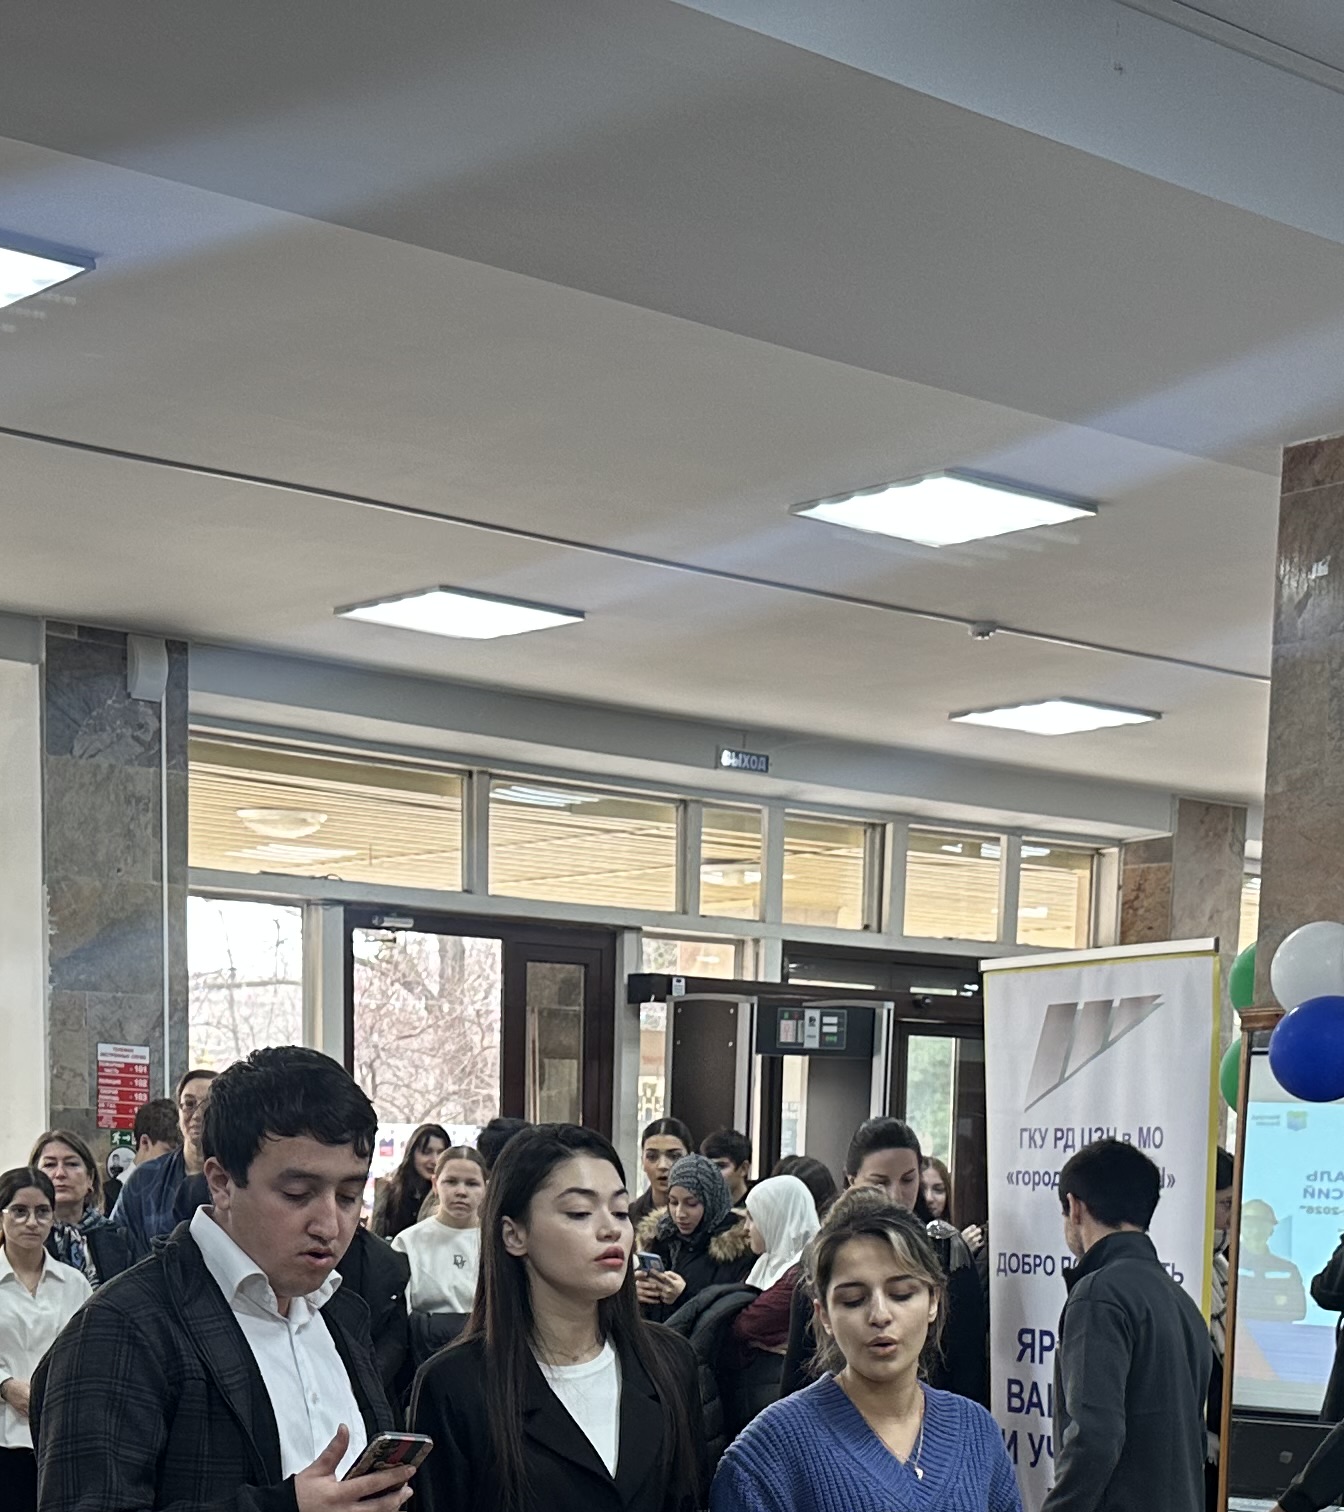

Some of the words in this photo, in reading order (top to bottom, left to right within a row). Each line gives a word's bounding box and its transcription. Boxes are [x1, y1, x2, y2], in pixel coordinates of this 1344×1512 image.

[1019, 1127, 1049, 1149] ГКУ
[1054, 1127, 1076, 1153] РД
[1138, 1126, 1164, 1149] МО
[997, 1252, 1055, 1277] ДОБРО
